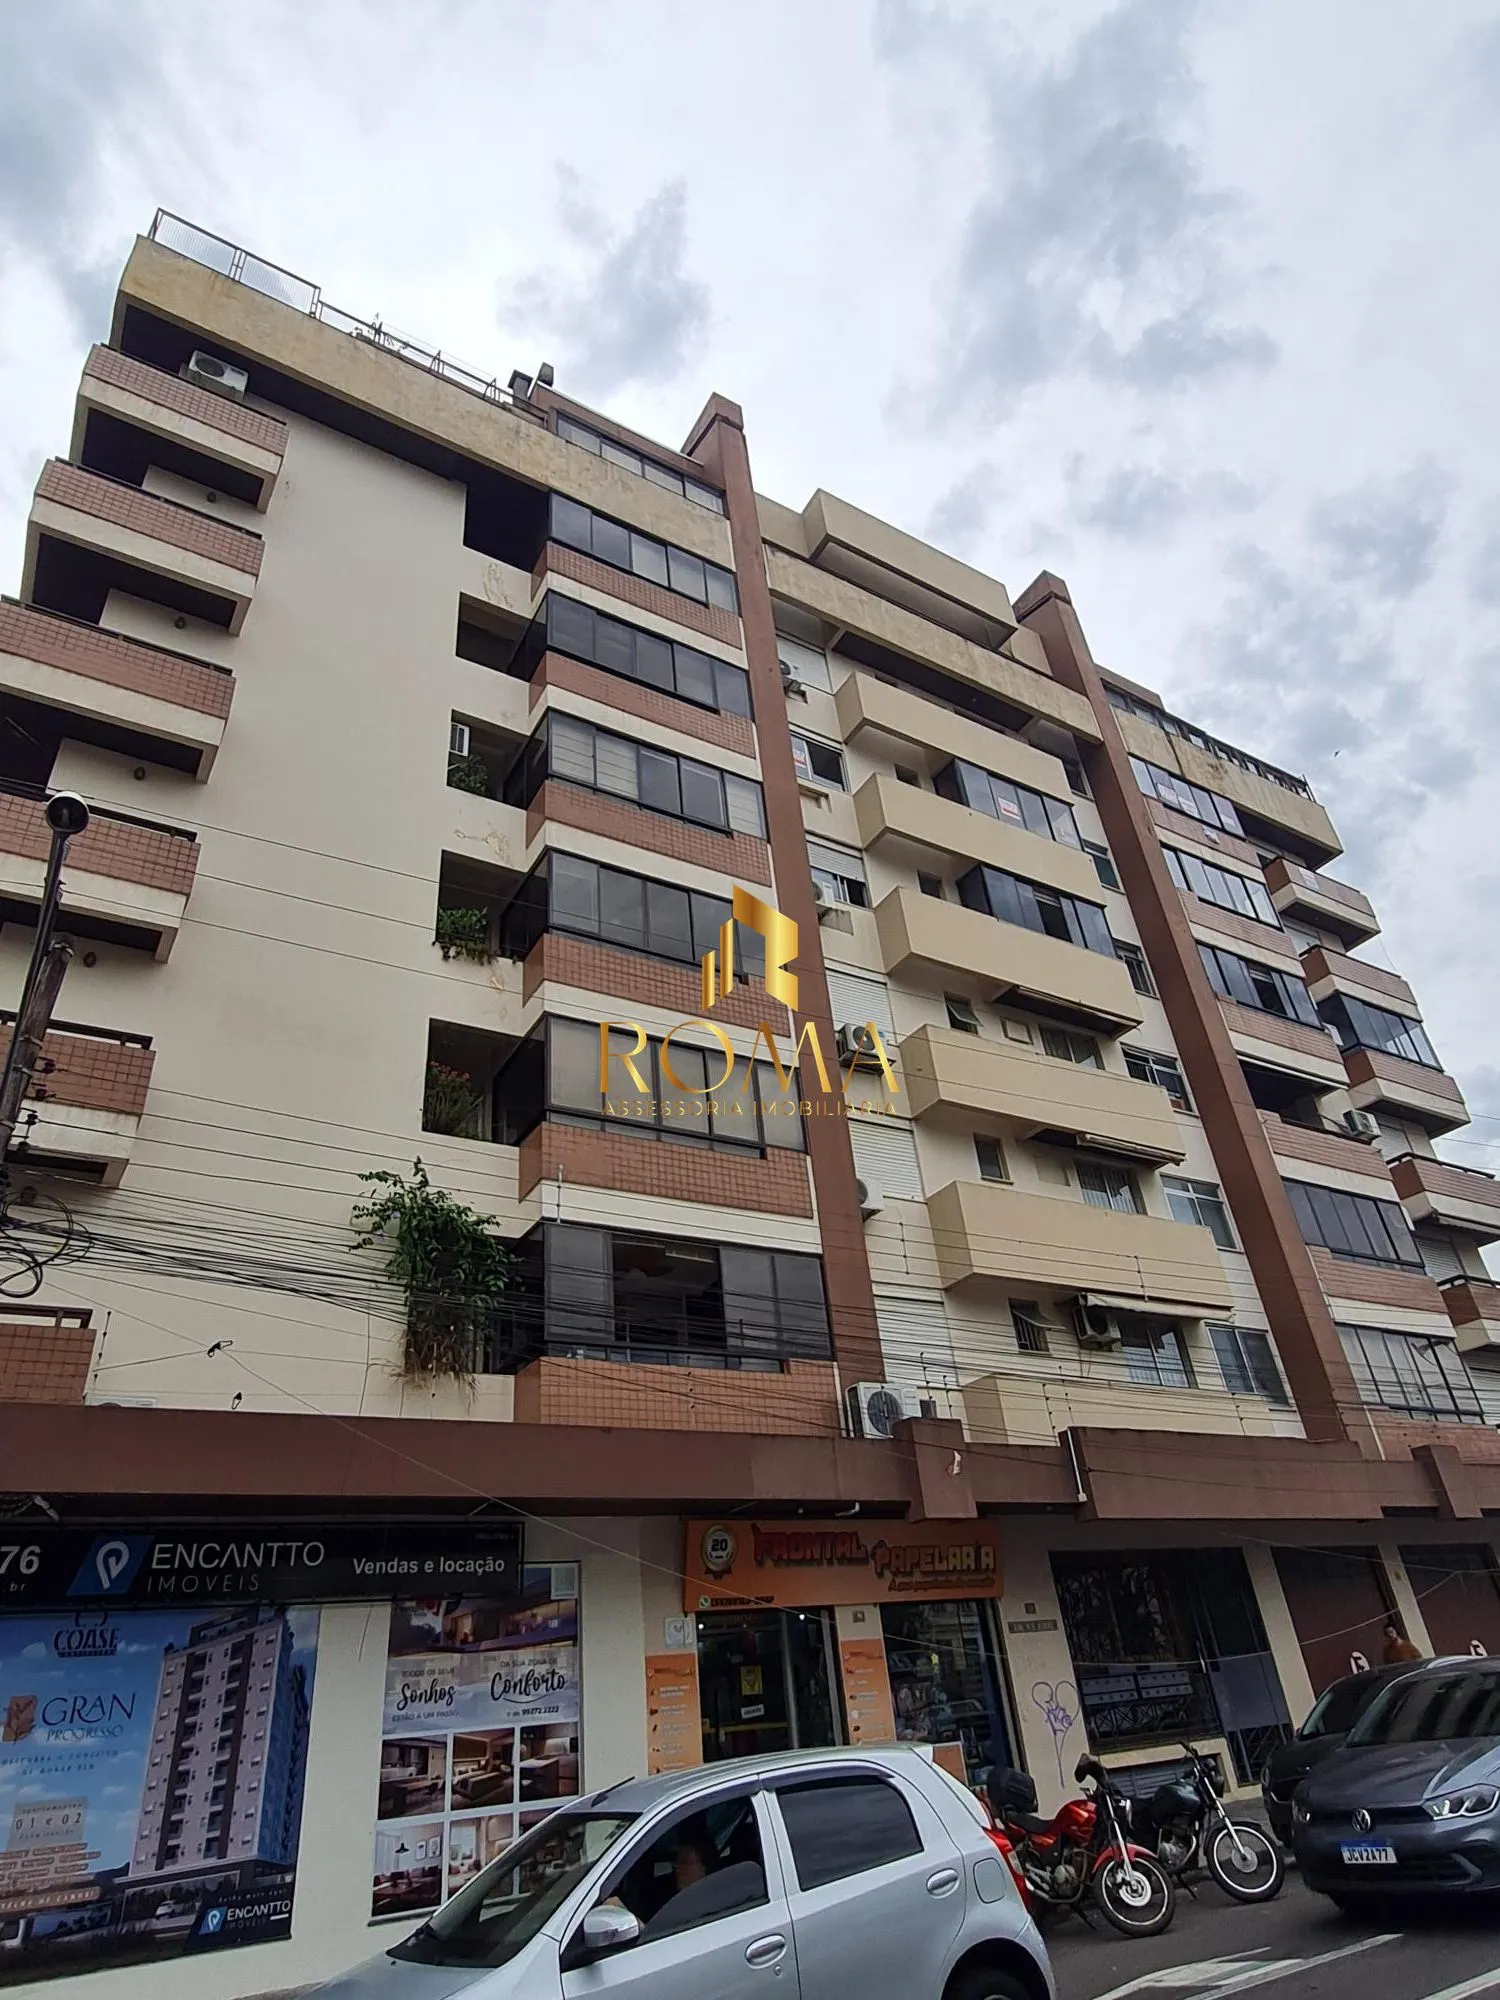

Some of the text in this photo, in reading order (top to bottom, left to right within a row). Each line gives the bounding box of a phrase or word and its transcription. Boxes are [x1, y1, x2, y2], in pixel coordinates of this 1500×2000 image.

[151, 1541, 325, 1569] ENCANTTO
[711, 1538, 728, 1552] 20
[752, 1525, 869, 1565] FRONTAL
[353, 1556, 505, 1576] Vendas e locação
[147, 1574, 260, 1593] IMOVEIS
[396, 1678, 457, 1711] Sonhos
[490, 1668, 566, 1702] Conforto
[41, 1692, 138, 1726] GRAN
[47, 1724, 124, 1742] PROGRESSO
[227, 1900, 291, 1921] ENCANTTO
